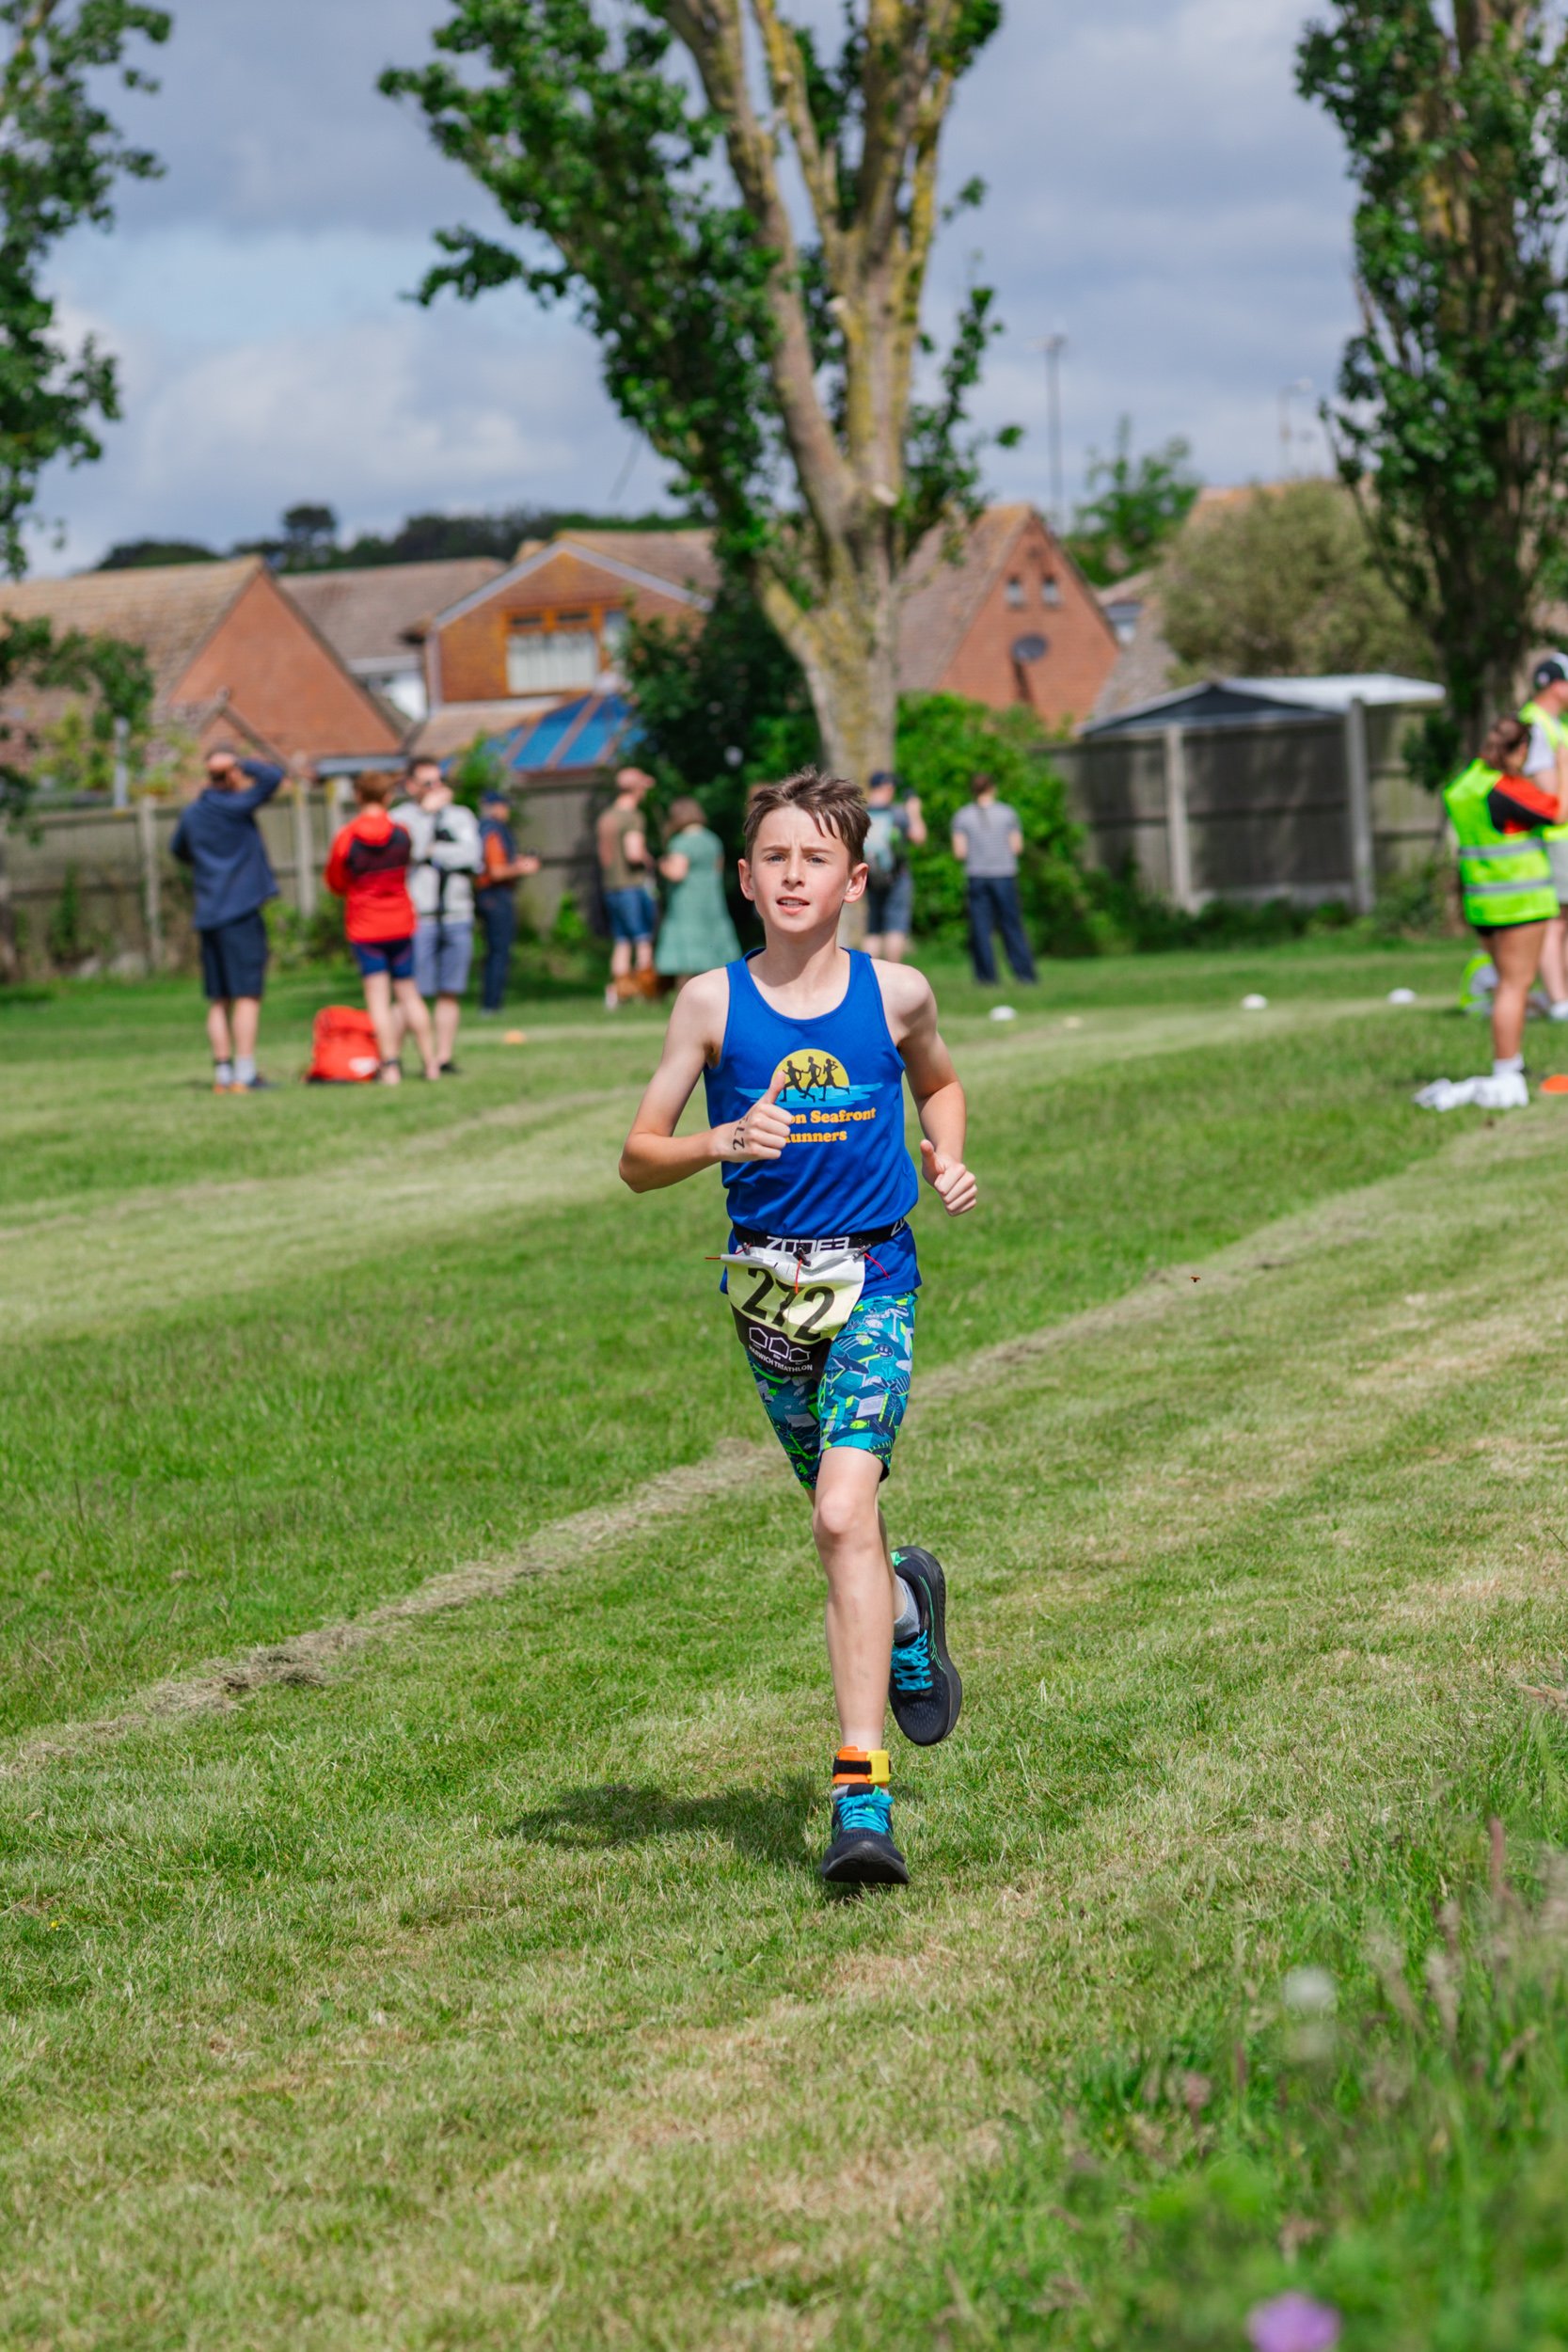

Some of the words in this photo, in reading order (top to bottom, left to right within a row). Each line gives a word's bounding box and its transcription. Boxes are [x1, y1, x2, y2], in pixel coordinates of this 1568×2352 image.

[810, 1107, 877, 1123] Seafront
[741, 1267, 835, 1341] 272
[773, 1360, 814, 1373] TRIATHLON
